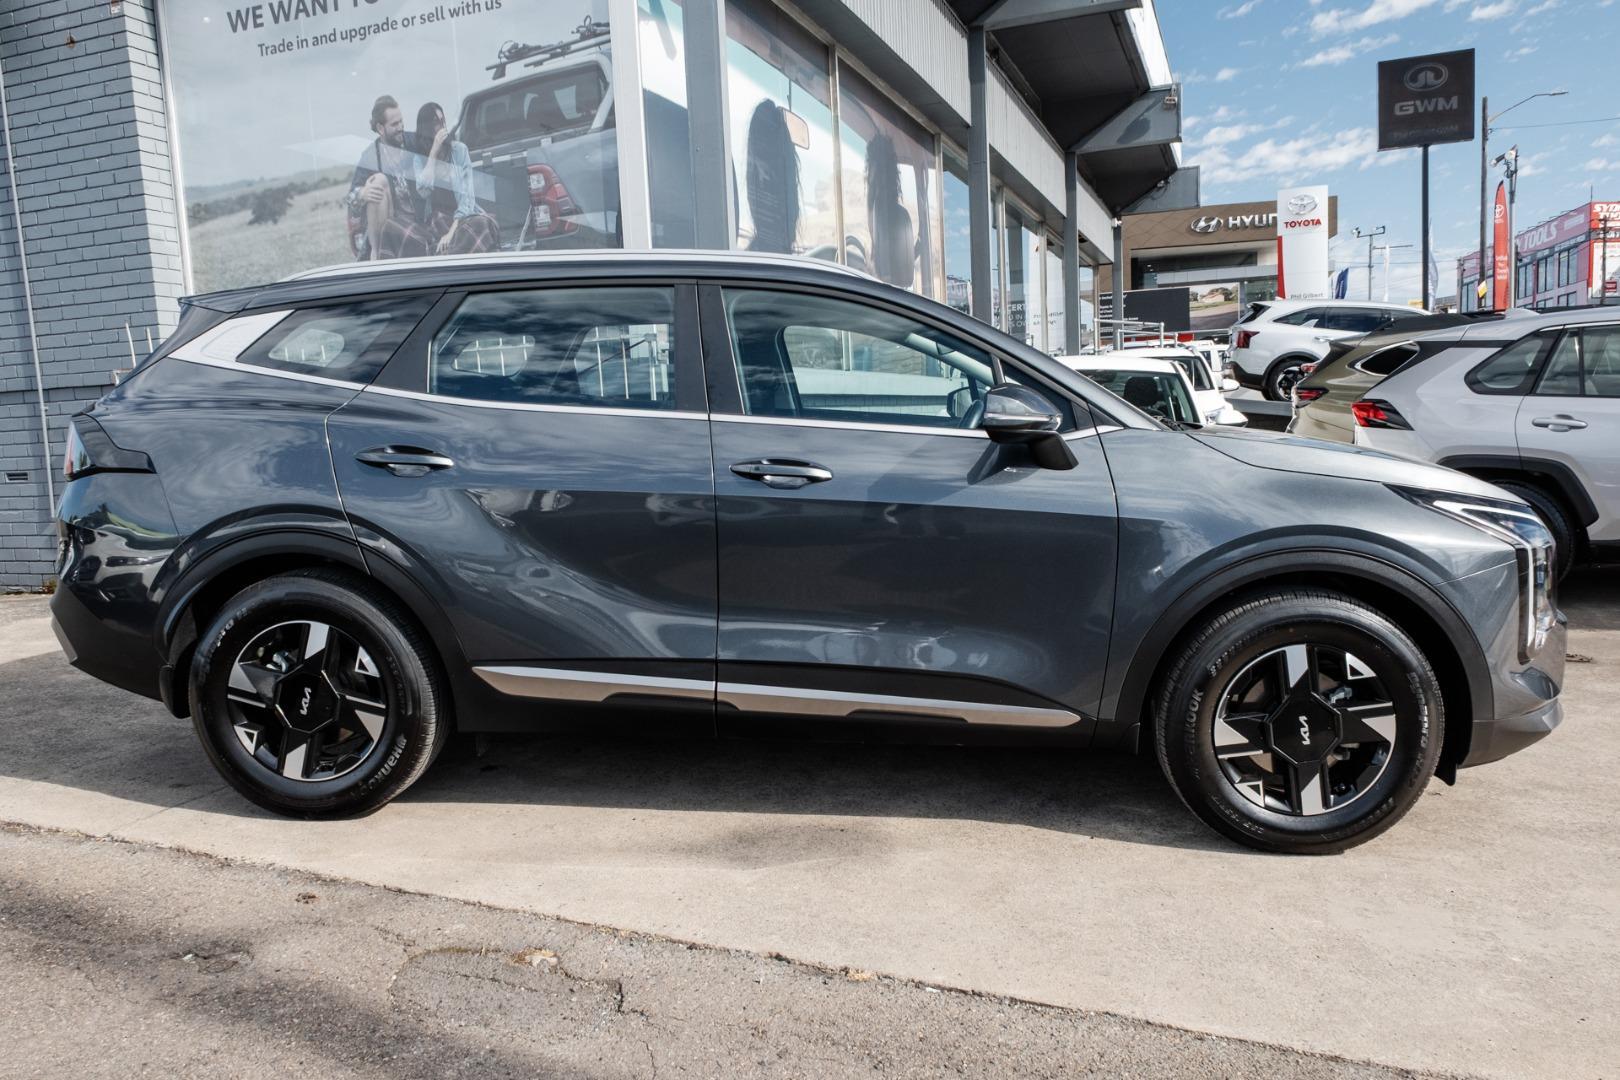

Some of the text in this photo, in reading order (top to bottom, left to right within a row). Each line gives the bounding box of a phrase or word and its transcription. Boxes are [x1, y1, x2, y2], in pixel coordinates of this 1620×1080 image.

[227, 5, 264, 33] WE
[258, 0, 502, 57] Trade in and upgrade or sell with us
[1394, 95, 1458, 116] GWM
[1284, 219, 1322, 229] TOYOTA
[1523, 221, 1559, 251] TOOLS
